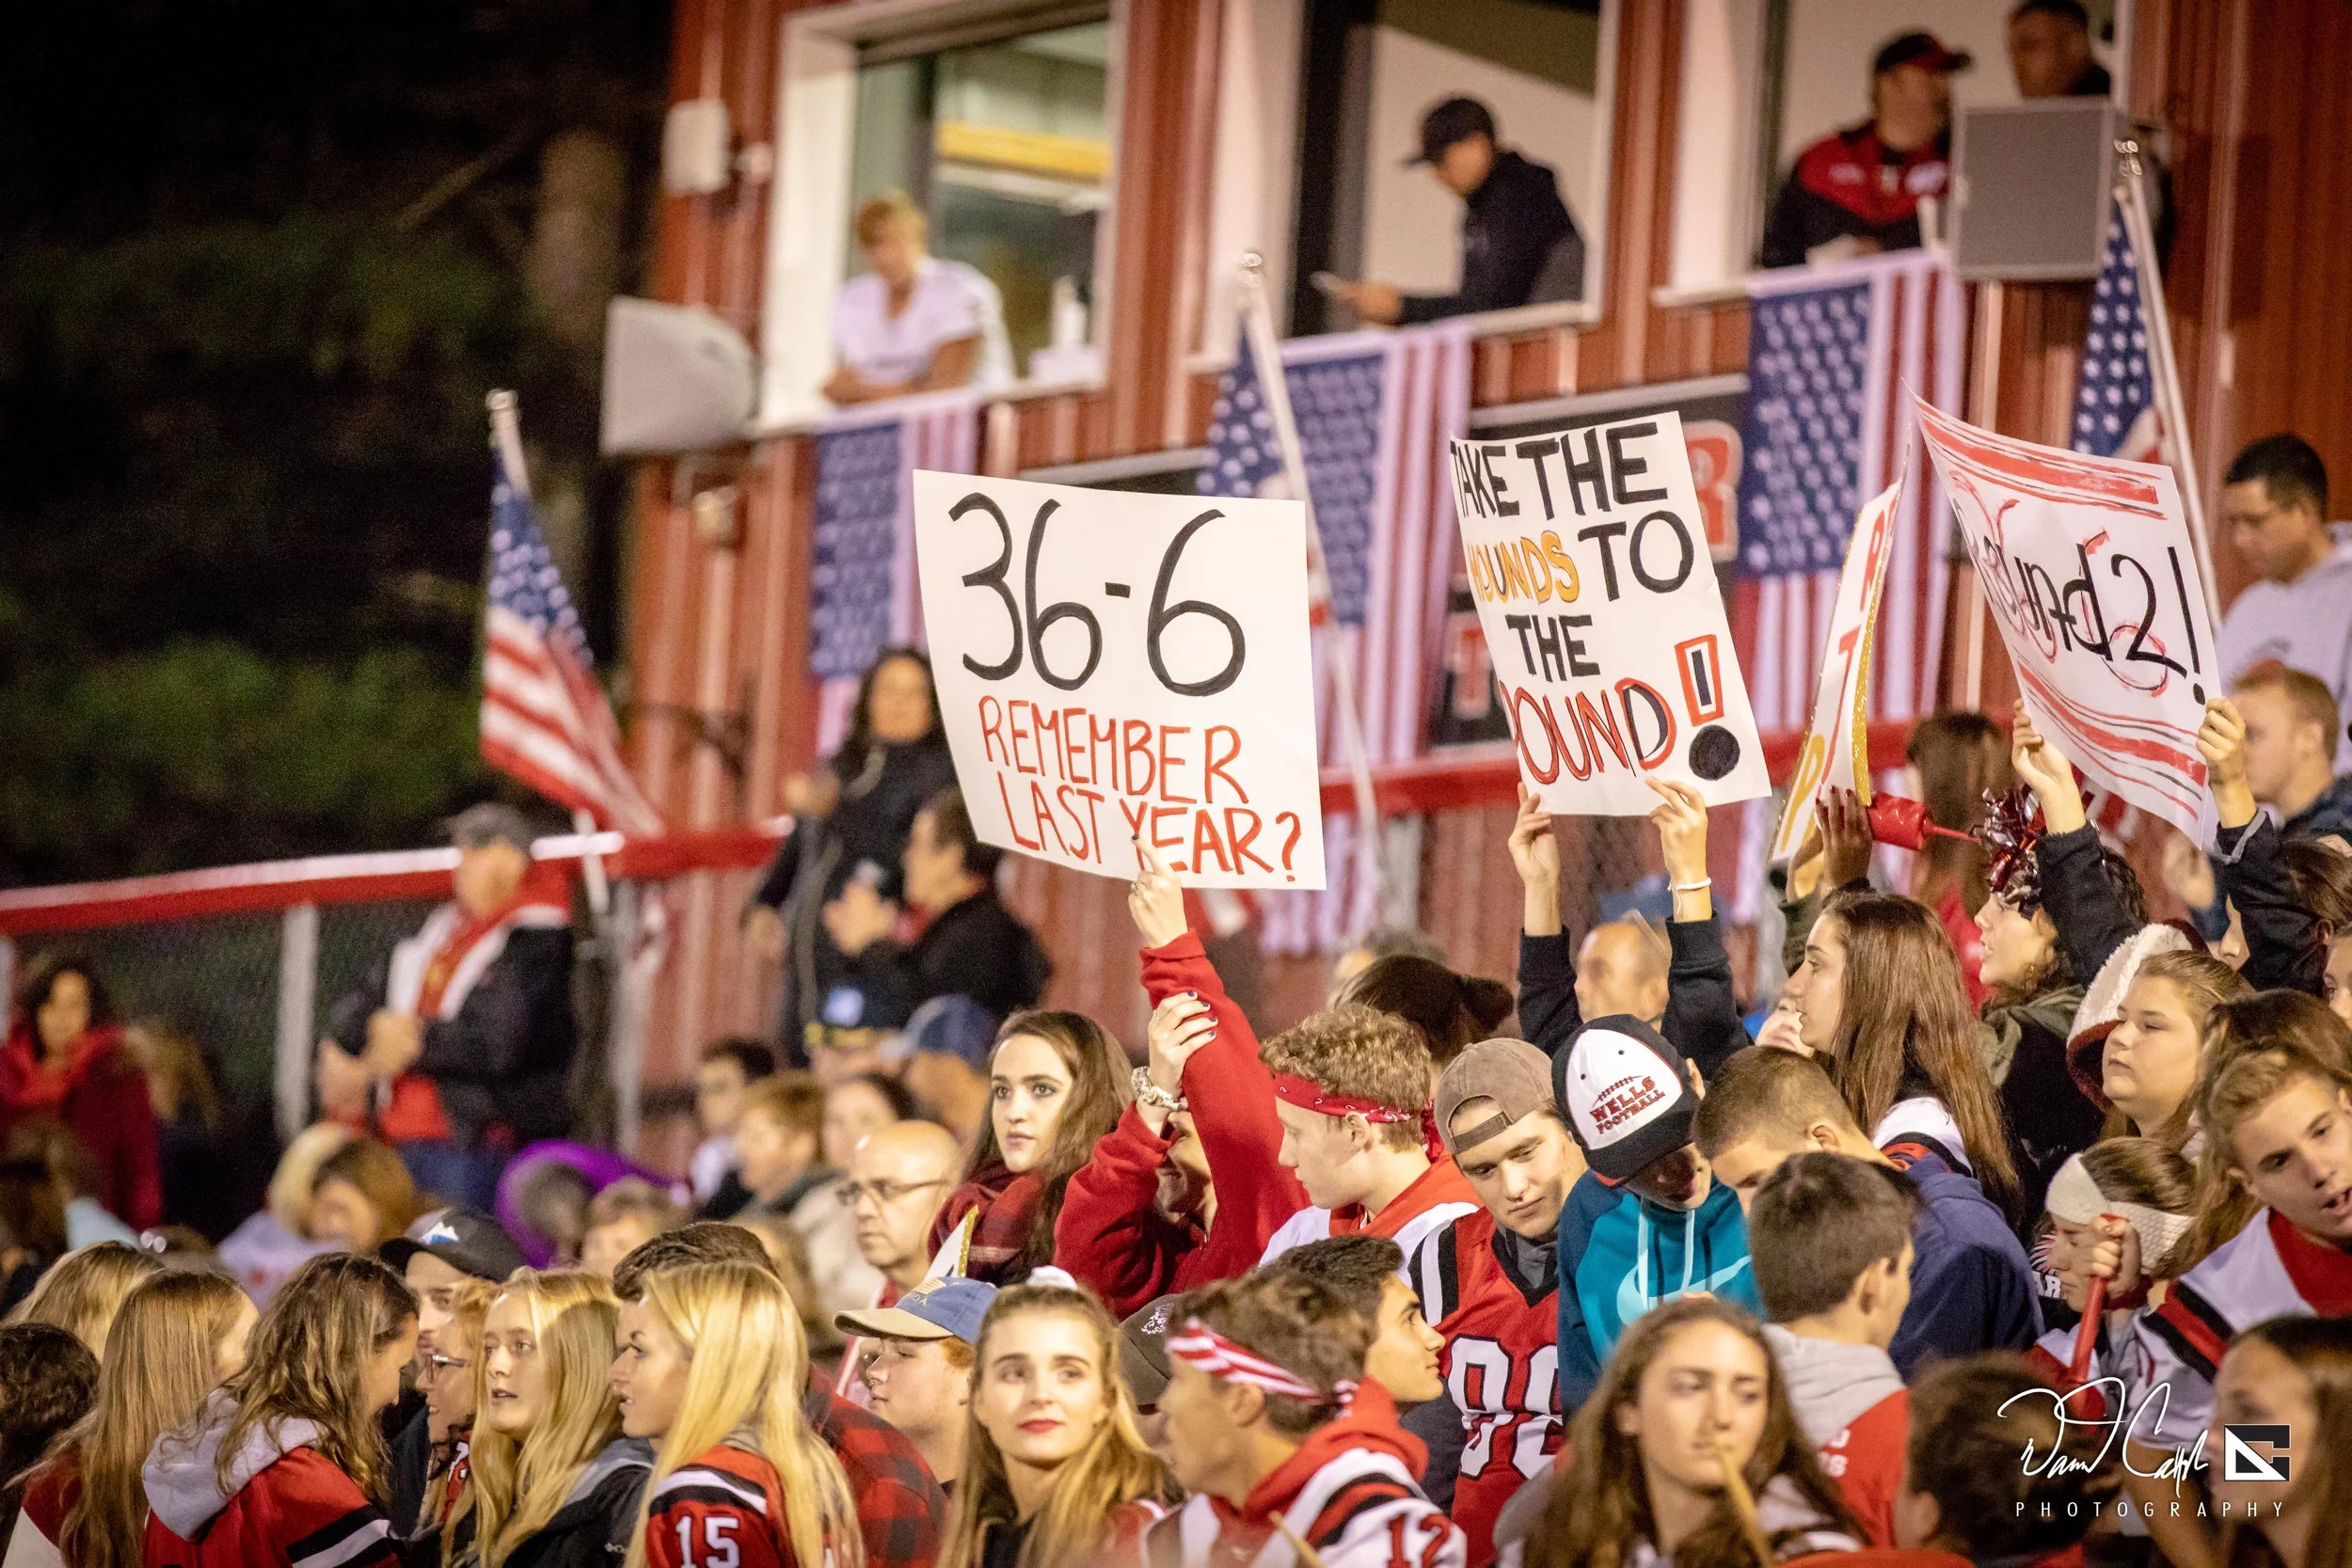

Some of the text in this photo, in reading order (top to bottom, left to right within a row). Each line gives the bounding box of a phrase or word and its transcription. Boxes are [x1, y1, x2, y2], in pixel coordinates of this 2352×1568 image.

[1516, 422, 1668, 520] THE
[948, 492, 1246, 697] 36-6
[1578, 510, 1694, 601] TO
[1505, 614, 1600, 683] THE
[978, 695, 1249, 804] REMEMBER
[997, 770, 1302, 882] LAST YEAR?
[1589, 1076, 1656, 1123] WELLS
[1596, 1089, 1666, 1134] FOOTBALL
[675, 1515, 741, 1568] 15
[1388, 1511, 1451, 1568] 12
